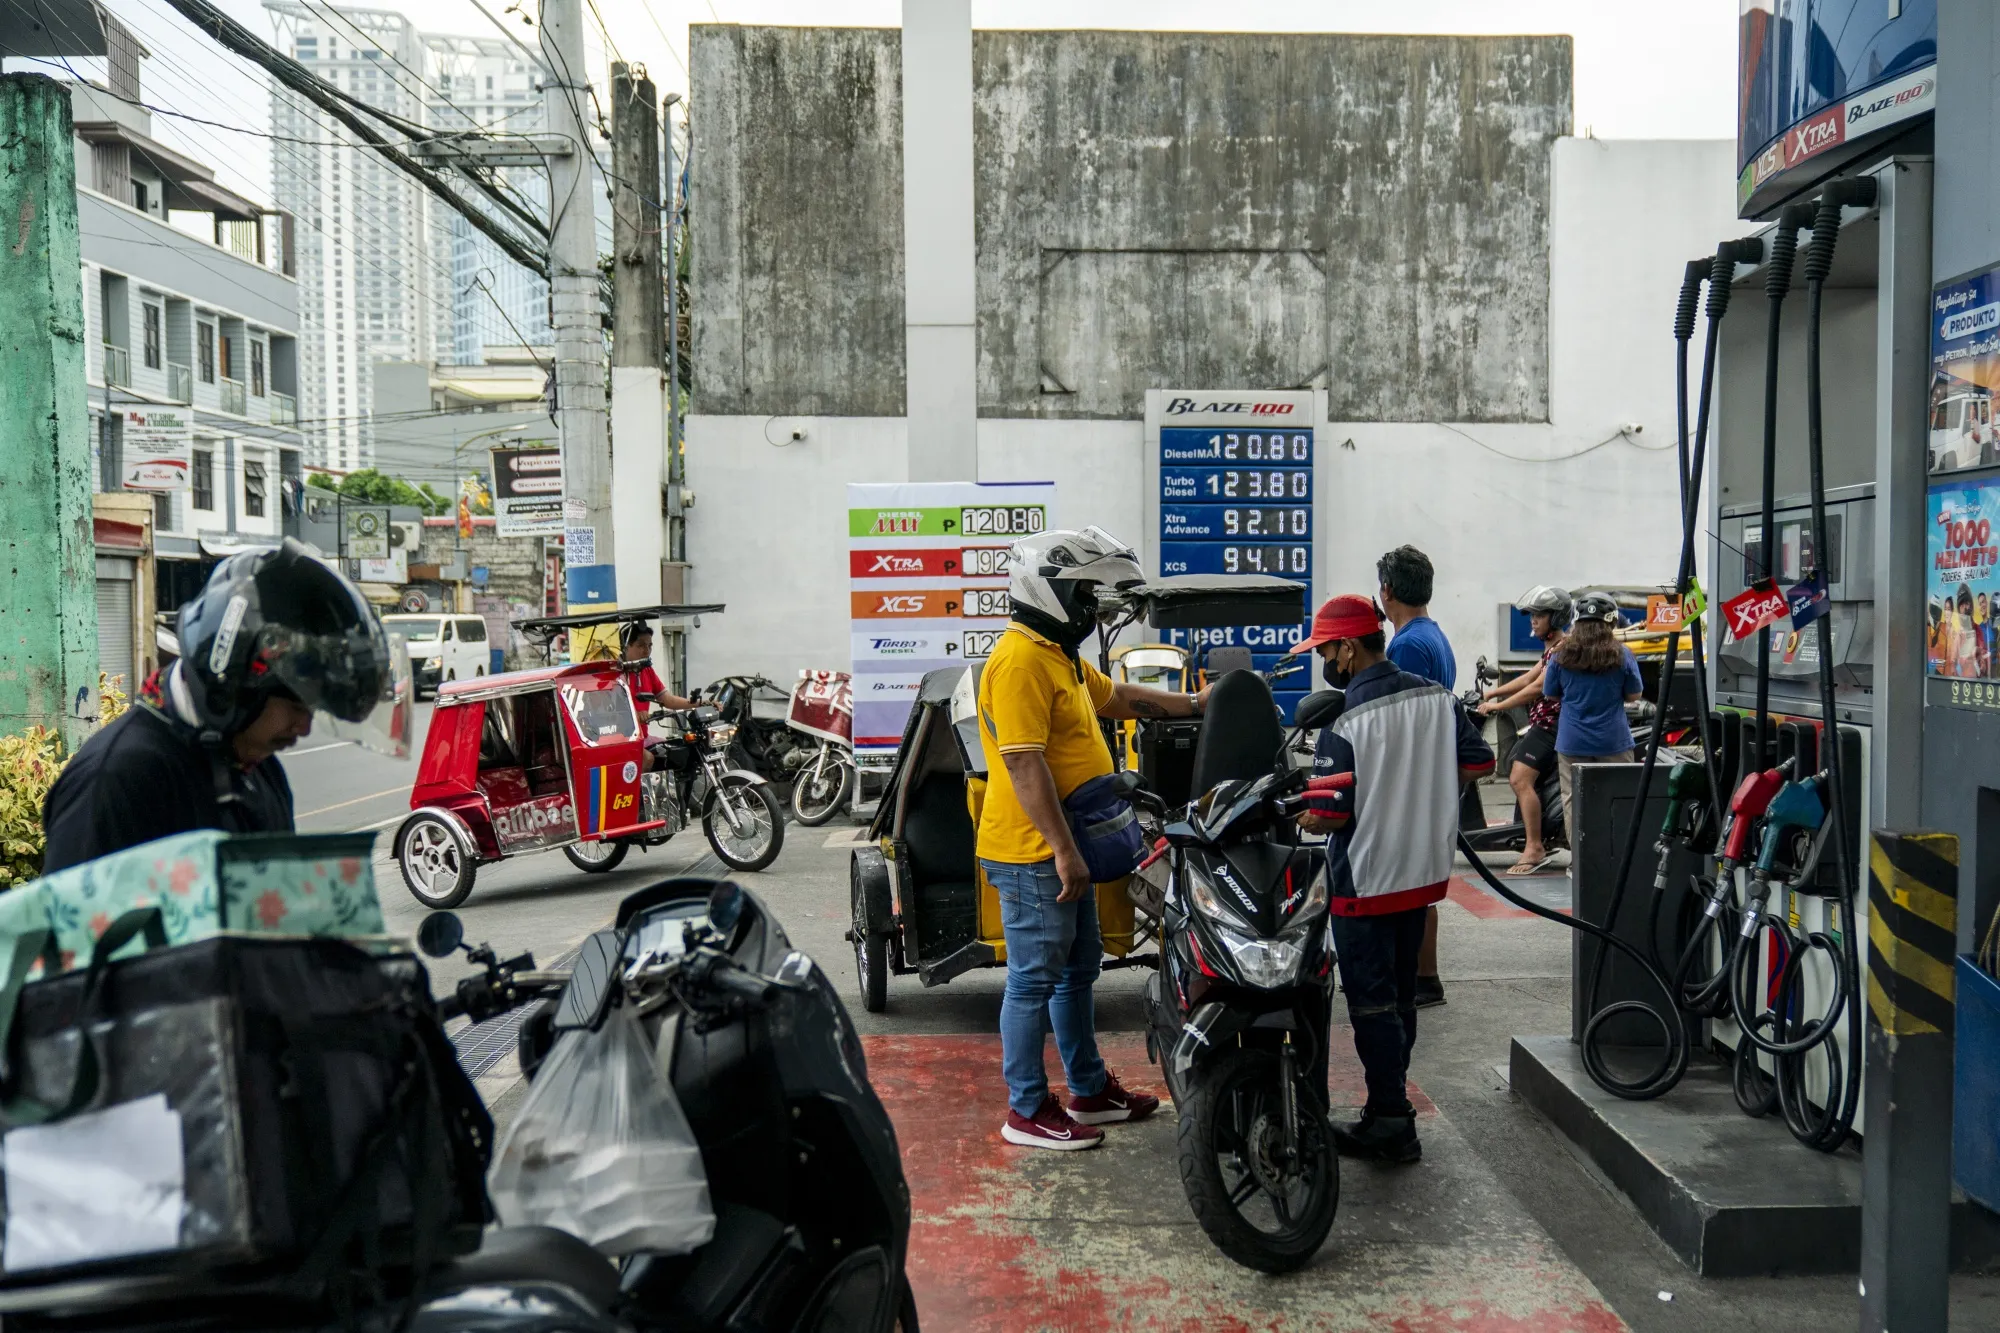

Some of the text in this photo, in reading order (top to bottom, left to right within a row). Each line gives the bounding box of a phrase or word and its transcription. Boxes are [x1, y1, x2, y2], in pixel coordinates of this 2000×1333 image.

[1791, 118, 1837, 162] XTRA
[1756, 144, 1778, 183] XCS
[1950, 308, 1996, 333] PRODUKTO
[1164, 476, 1195, 486] Turbo
[1164, 487, 1196, 497] Diesel
[965, 510, 1042, 534] 120.80
[1165, 509, 1307, 534] Xtra 92.10
[1165, 525, 1210, 534] Advance
[1945, 519, 1990, 549] 1000
[868, 555, 923, 572] XTRA
[1165, 547, 1307, 573] XCS 94.10
[1935, 546, 1998, 570] HELMETS
[876, 596, 927, 613] XCS
[1652, 607, 1680, 623] XCS
[1735, 595, 1783, 632] XTRA
[869, 639, 918, 649] TURBO
[967, 633, 1004, 655] 12
[1243, 624, 1303, 645] Card
[495, 803, 574, 835] ollibee
[1223, 875, 1258, 913] DUNLOP
